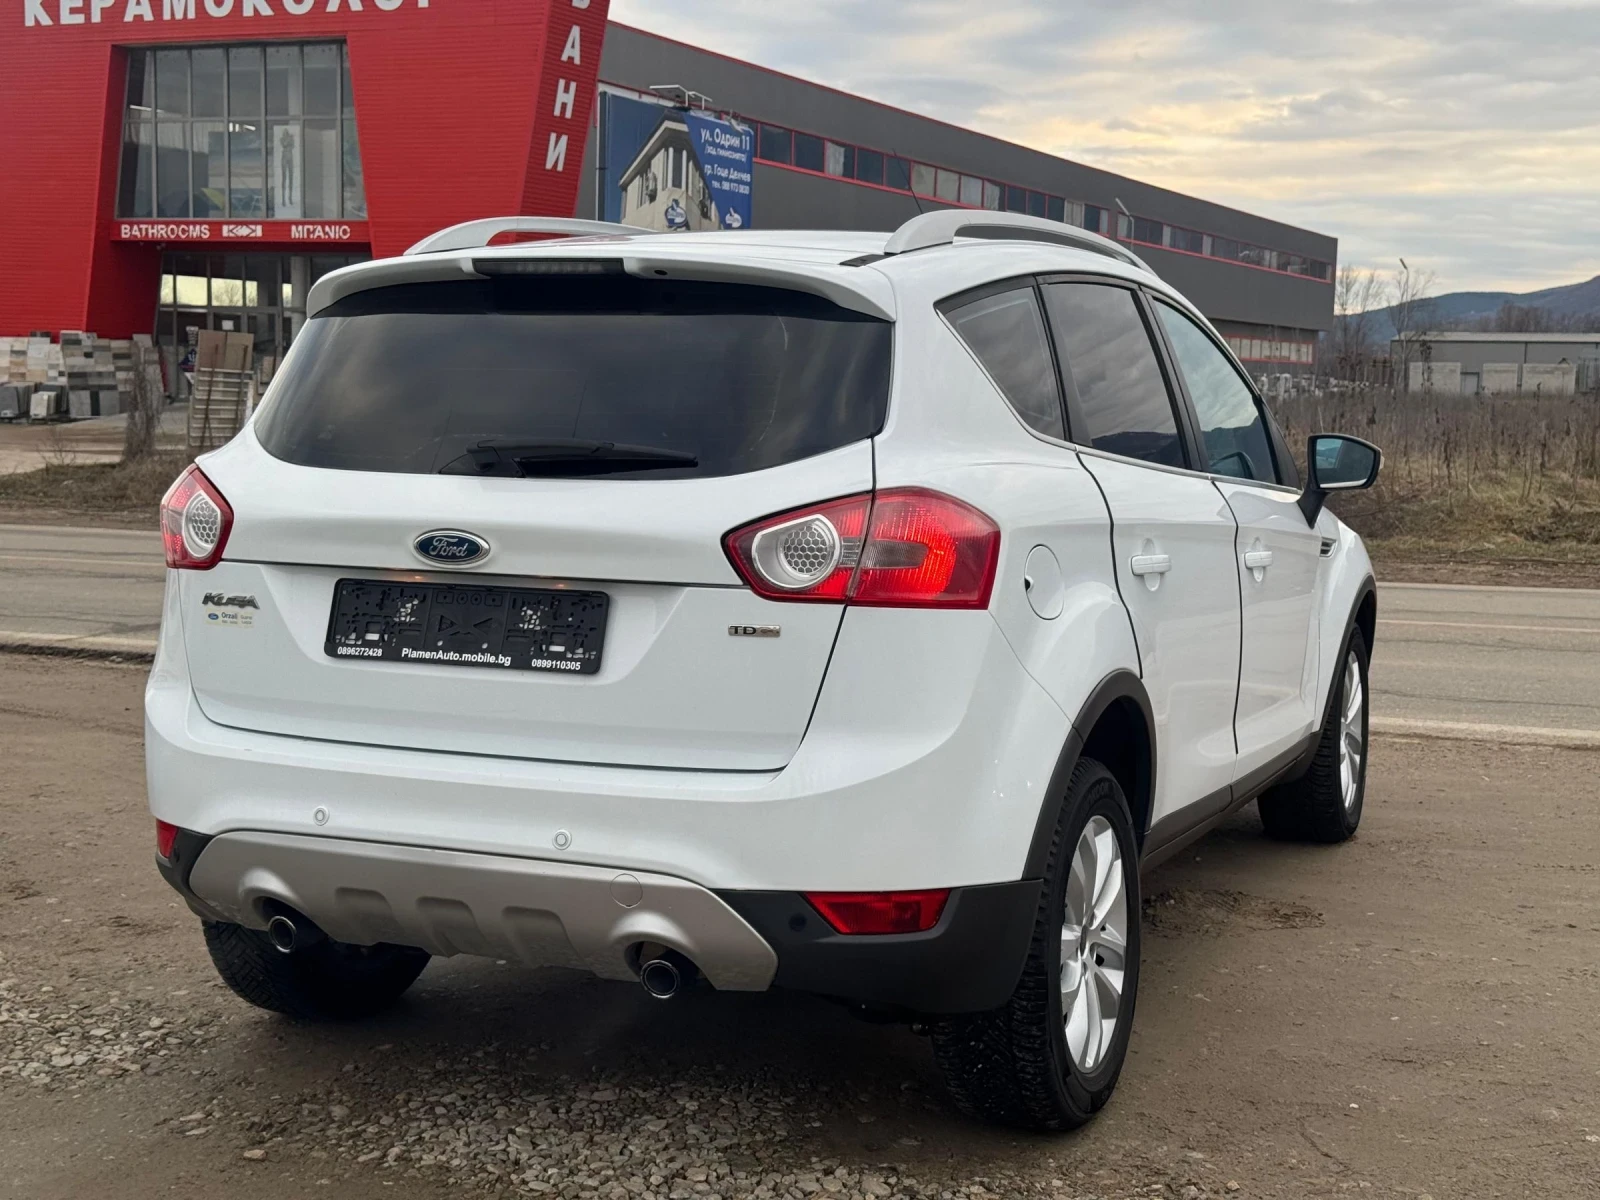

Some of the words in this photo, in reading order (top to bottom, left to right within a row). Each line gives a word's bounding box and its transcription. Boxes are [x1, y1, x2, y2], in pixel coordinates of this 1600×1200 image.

[544, 0, 591, 173] АНИ
[701, 128, 713, 143] ул.
[714, 127, 740, 148] Одрин
[742, 135, 750, 151] 11
[714, 163, 729, 178] Гоце
[428, 536, 469, 557] Ford
[337, 646, 383, 657] 0896272428
[401, 647, 512, 666] PlamenAuto.mobile.bg
[531, 658, 581, 671] 0899110305
